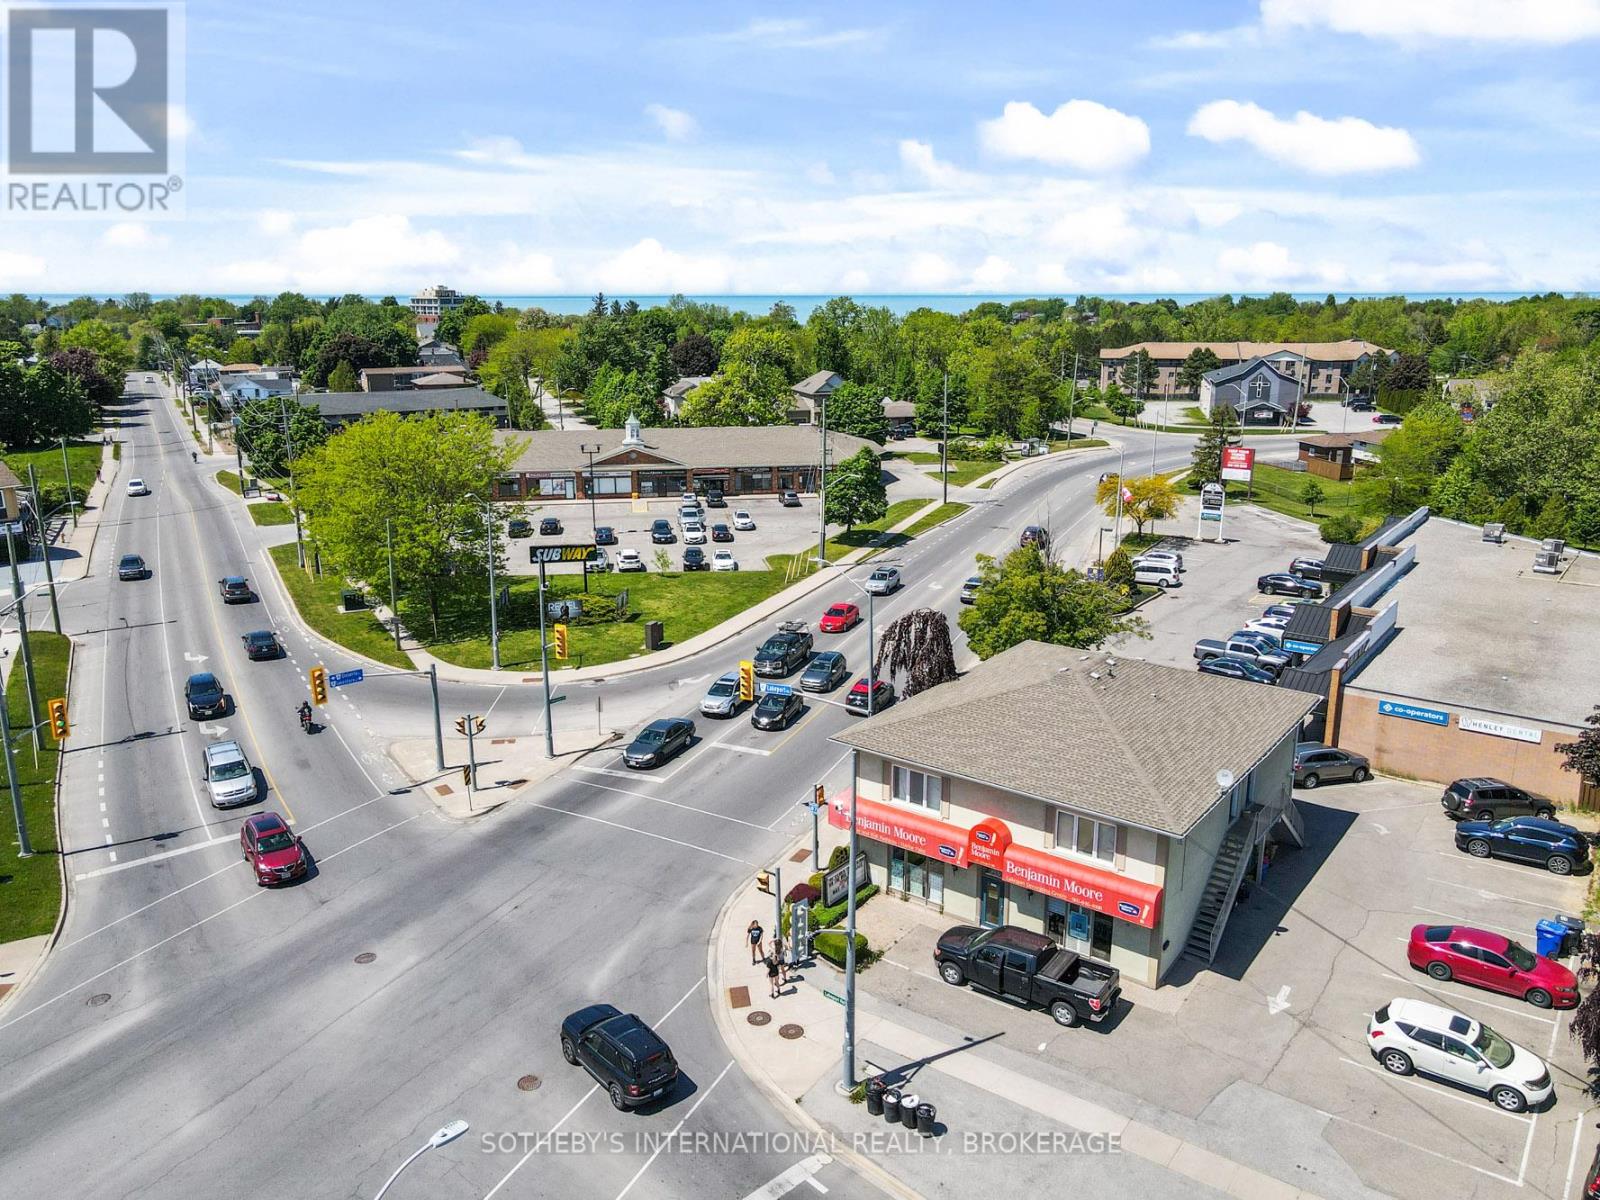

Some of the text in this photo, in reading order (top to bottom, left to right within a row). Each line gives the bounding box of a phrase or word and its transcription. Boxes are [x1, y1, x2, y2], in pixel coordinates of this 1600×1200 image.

[532, 547, 594, 562] SUBWAY
[1394, 706, 1444, 721] co-operators
[1472, 720, 1503, 732] HENLEY
[893, 825, 927, 846] Moore
[970, 849, 991, 861] Moore
[971, 842, 1000, 857] Benjamin
[1006, 860, 1103, 901] Benjamin Moore
